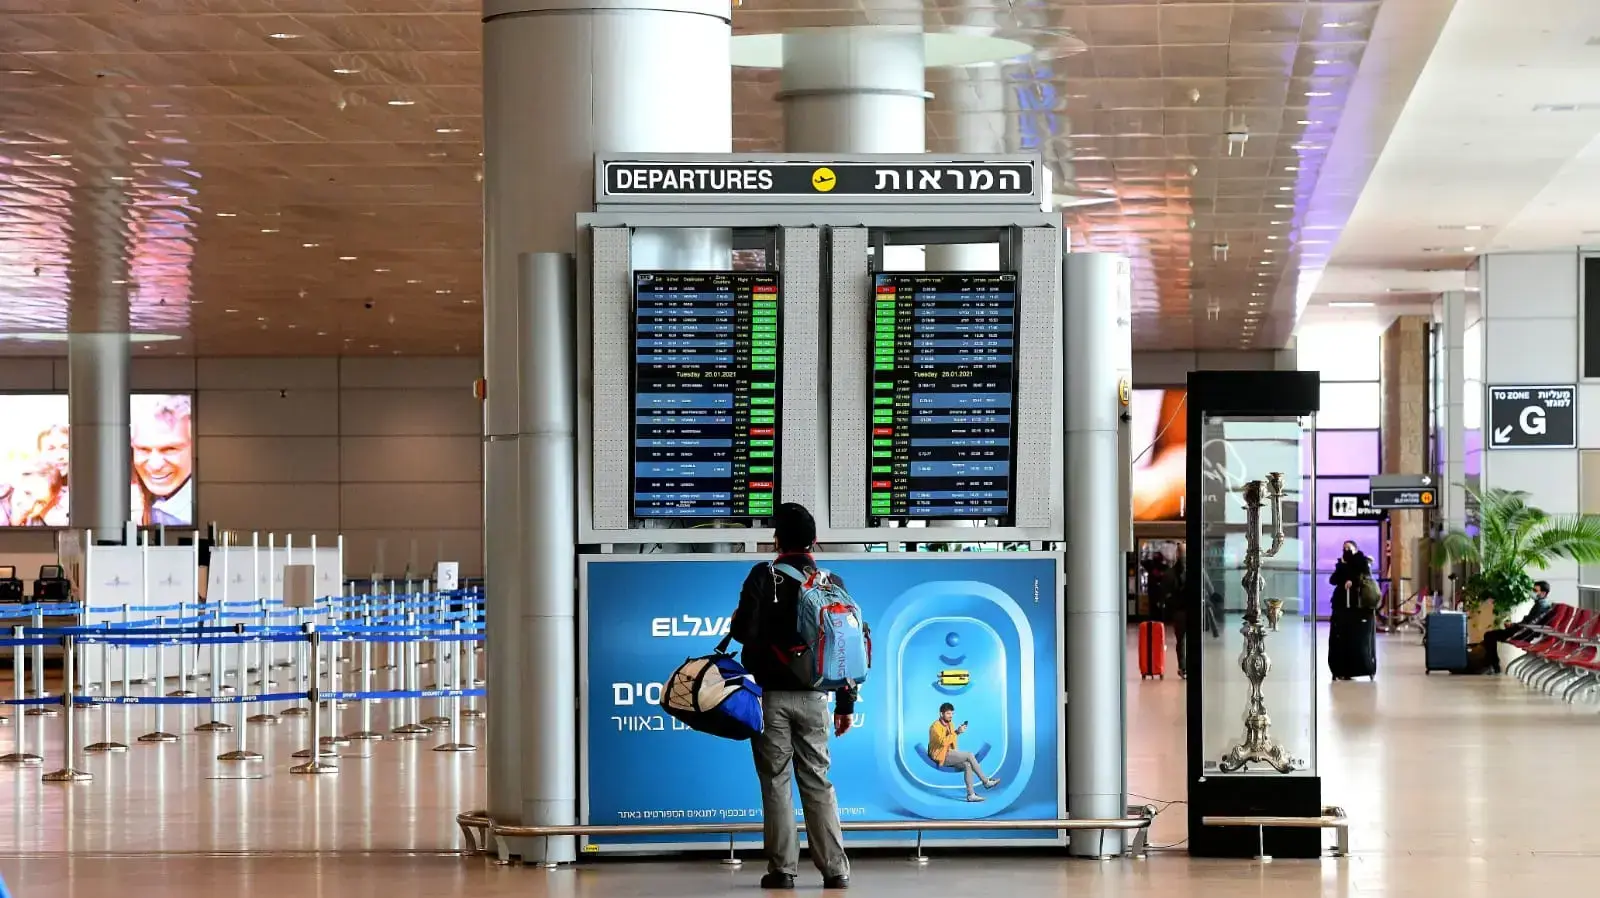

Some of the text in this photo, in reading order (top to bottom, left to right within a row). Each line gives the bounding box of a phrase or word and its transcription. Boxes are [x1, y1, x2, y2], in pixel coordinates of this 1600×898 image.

[616, 169, 773, 190] DEPARTURES
[874, 169, 1021, 190] המראות
[1494, 391, 1530, 400] TO ZONE
[1519, 405, 1546, 435] G
[611, 715, 665, 731] באוויר
[617, 810, 642, 819] באתר
[687, 808, 716, 818] לתנאים
[719, 808, 747, 819] ובכפוף
